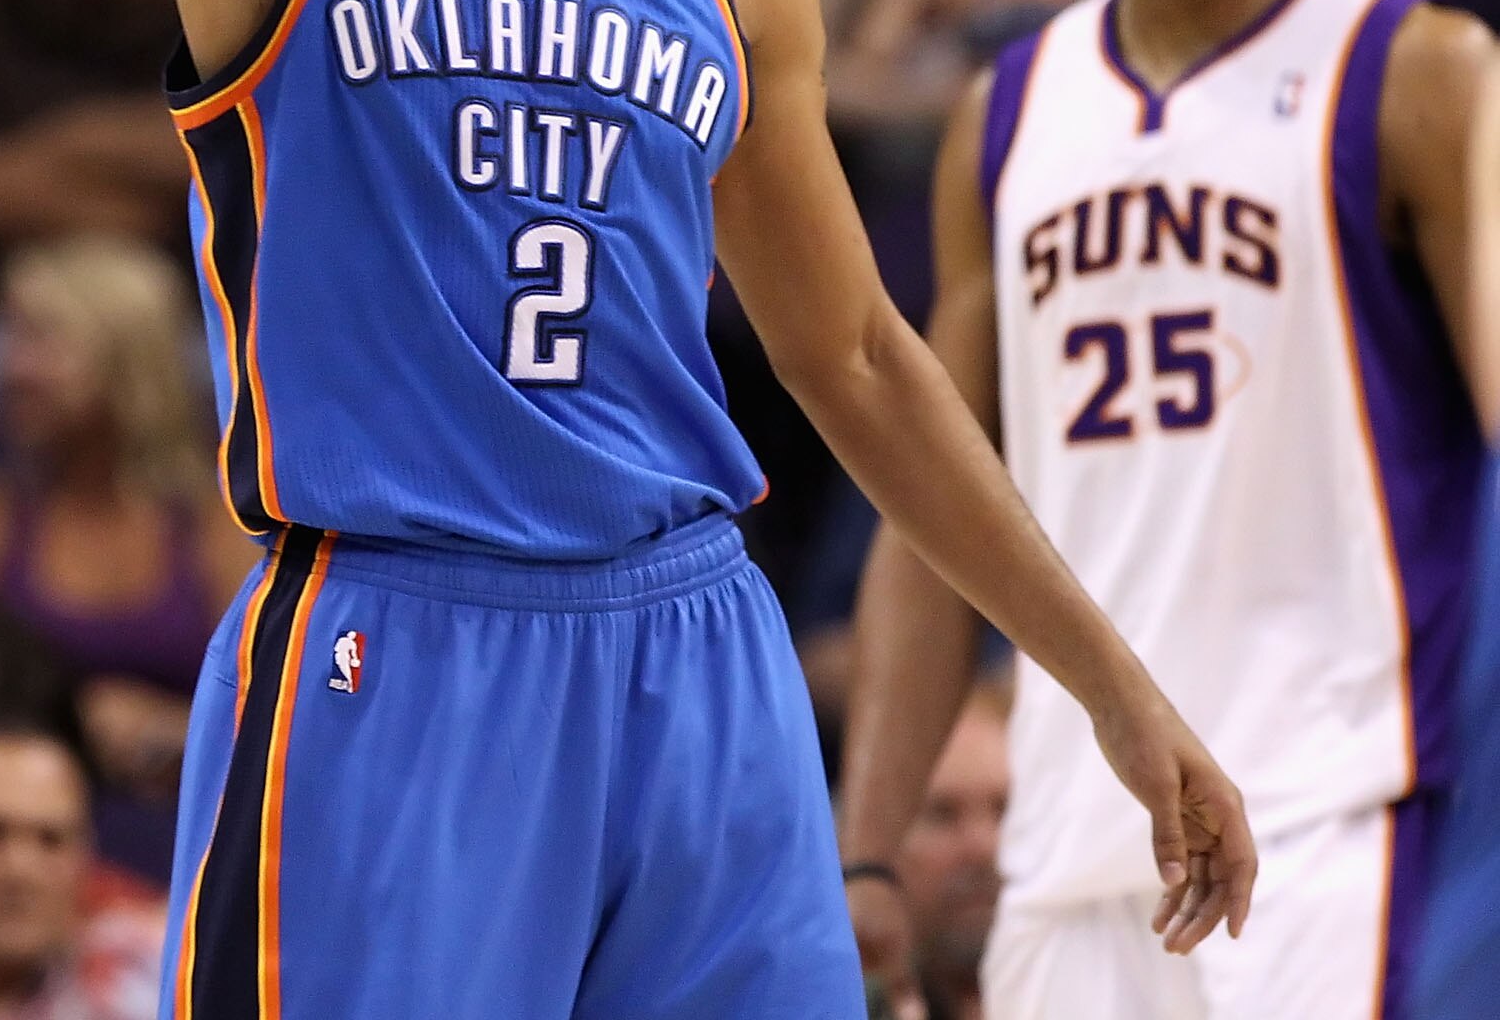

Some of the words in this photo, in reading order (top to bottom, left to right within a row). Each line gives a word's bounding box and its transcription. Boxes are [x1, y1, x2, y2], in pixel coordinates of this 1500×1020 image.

[454, 96, 632, 212] CITY
[503, 217, 595, 386] 2
[1023, 182, 1283, 308] SUNS
[1064, 311, 1217, 444] 25
